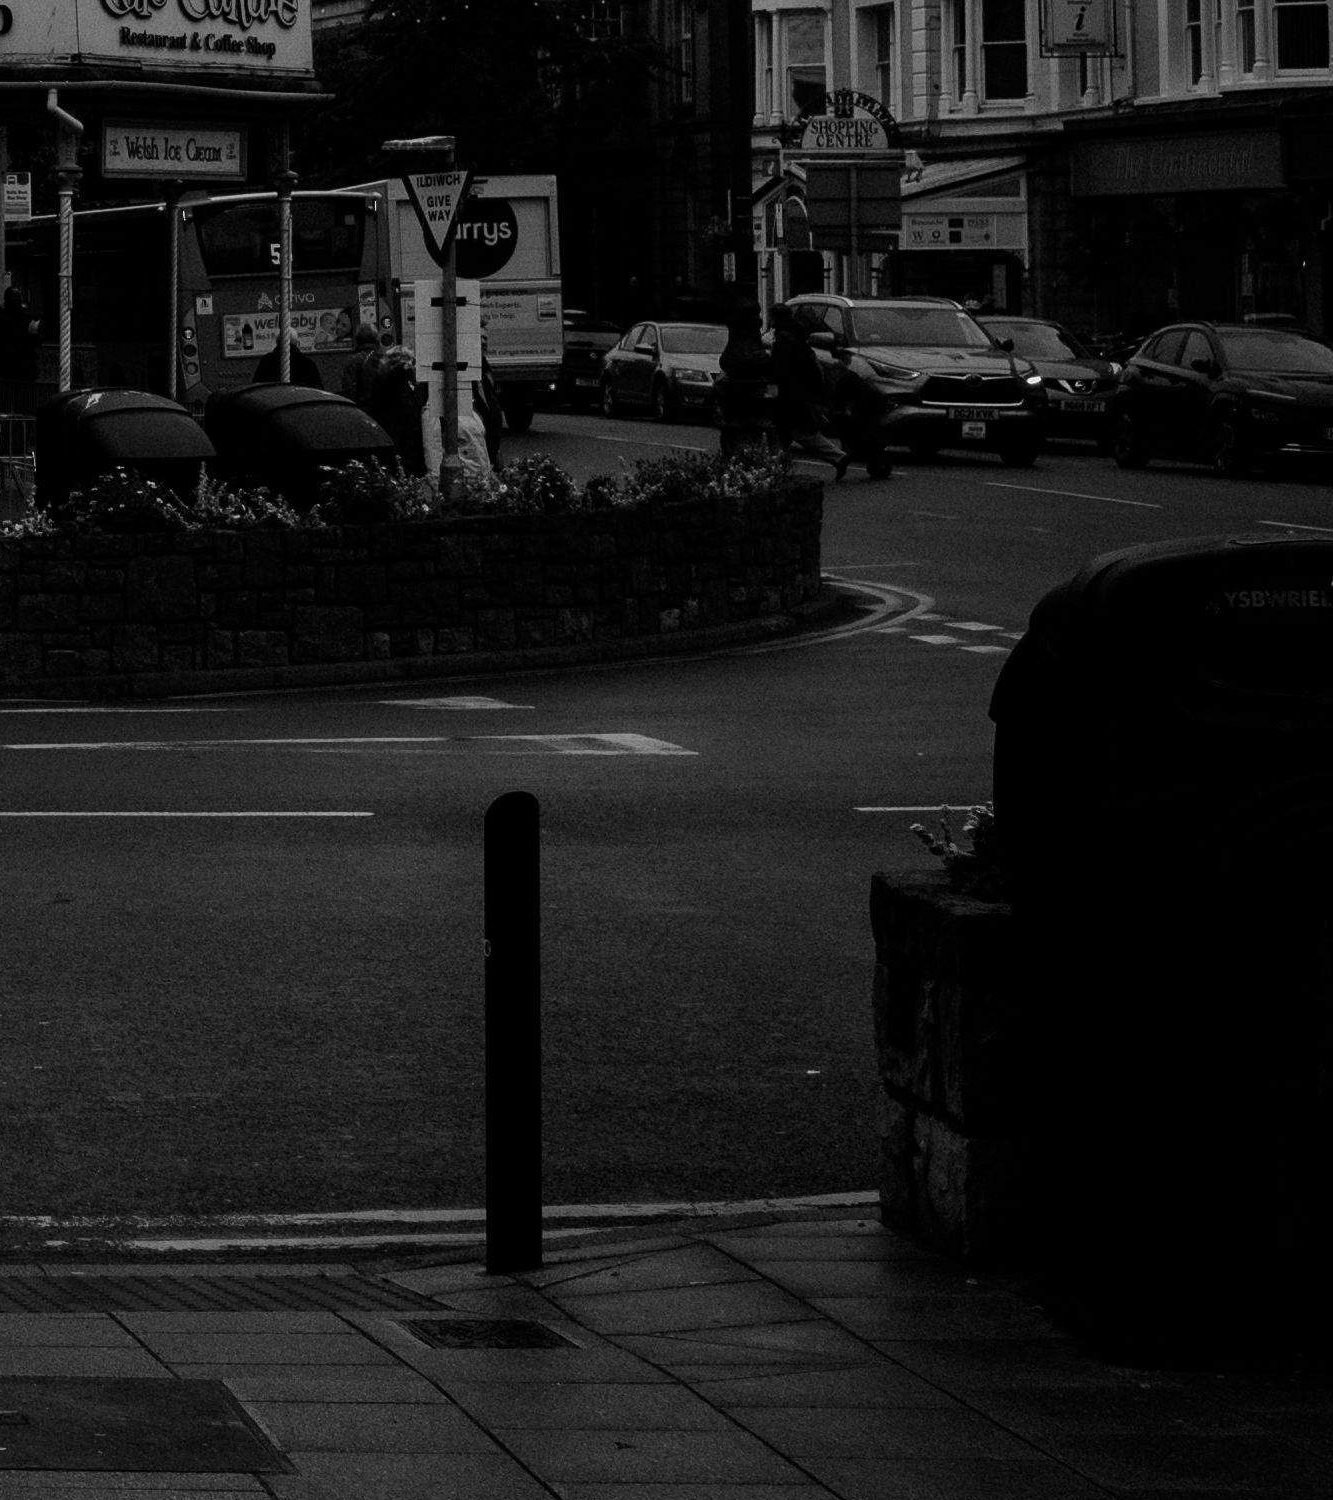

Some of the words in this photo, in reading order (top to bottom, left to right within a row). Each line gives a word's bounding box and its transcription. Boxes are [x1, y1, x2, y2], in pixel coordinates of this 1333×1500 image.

[120, 25, 188, 51] Restaurant
[190, 31, 202, 51] &
[204, 32, 244, 54] Coffee
[245, 36, 277, 60] Shop
[810, 120, 879, 135] SHOPPING
[815, 134, 874, 148] CENTRE
[124, 136, 159, 161] Welsh
[163, 137, 182, 162] Ice
[186, 138, 223, 163] Cream
[1113, 146, 1143, 179] The
[1148, 142, 1255, 178] Continental
[416, 174, 461, 188] ILDIWCH
[427, 195, 452, 208] GIVE
[427, 210, 452, 222] WAY
[1223, 589, 1332, 609] YSBWRIEL
